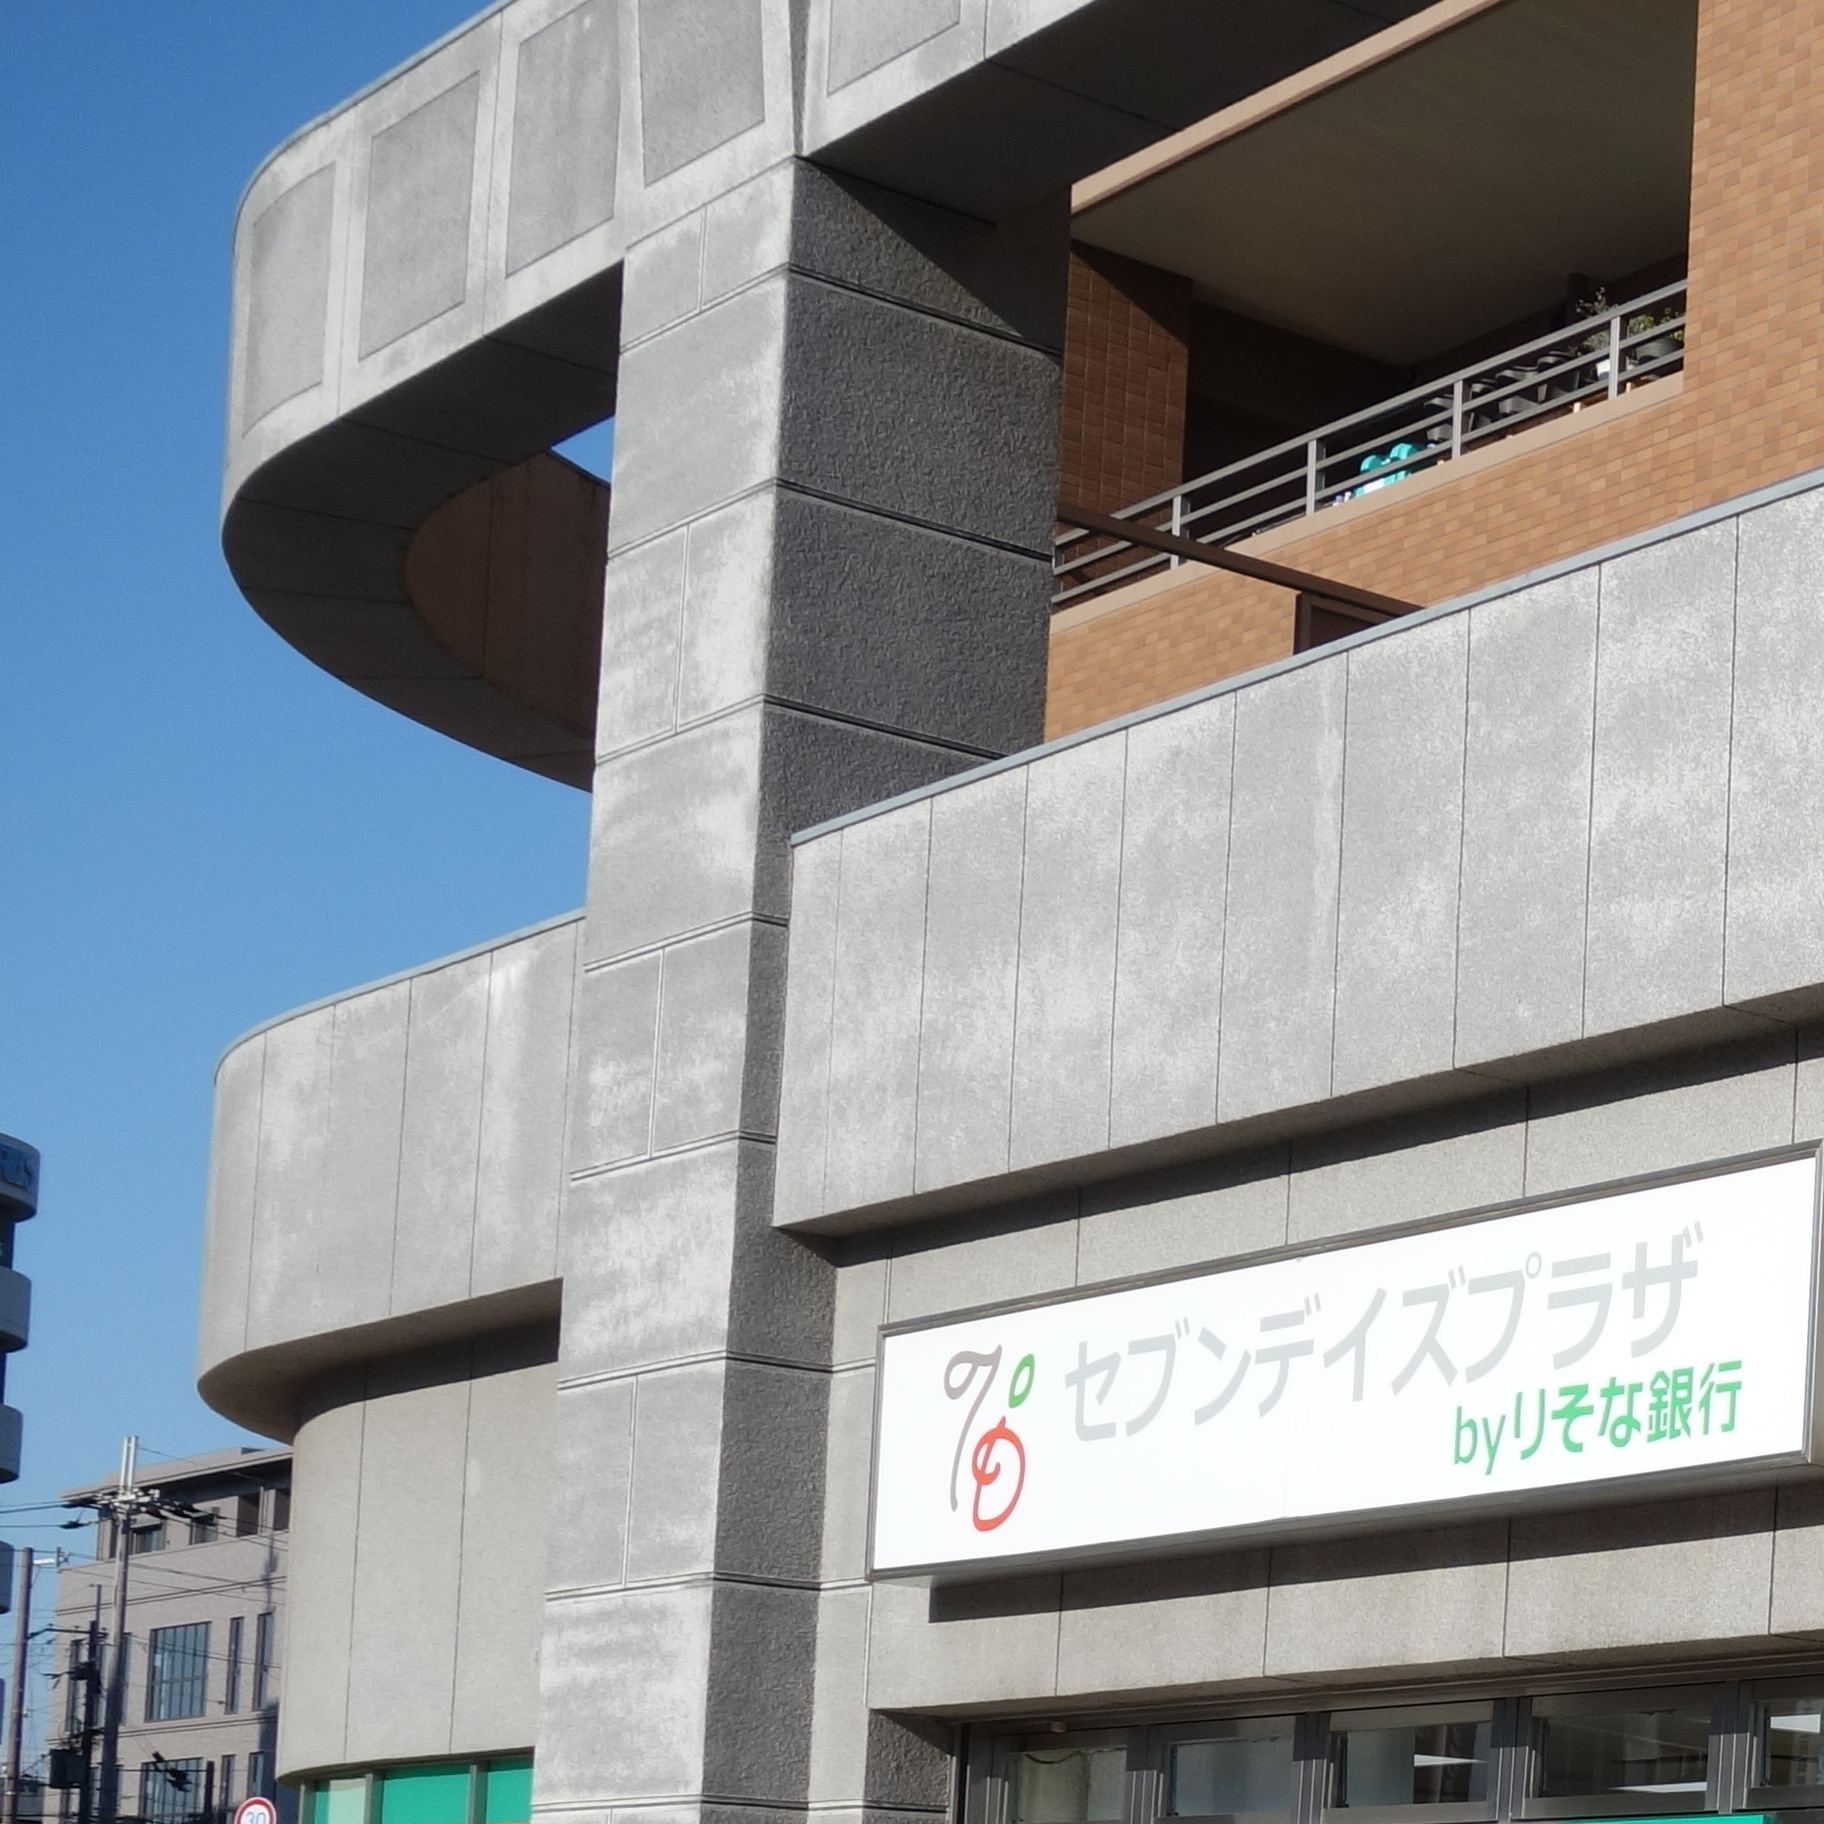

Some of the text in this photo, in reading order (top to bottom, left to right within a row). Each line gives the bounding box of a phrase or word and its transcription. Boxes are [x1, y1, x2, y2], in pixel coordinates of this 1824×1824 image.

[1064, 1221, 1704, 1443] セブンデイズプラザ
[1452, 1360, 1744, 1476] byりそな銀行
